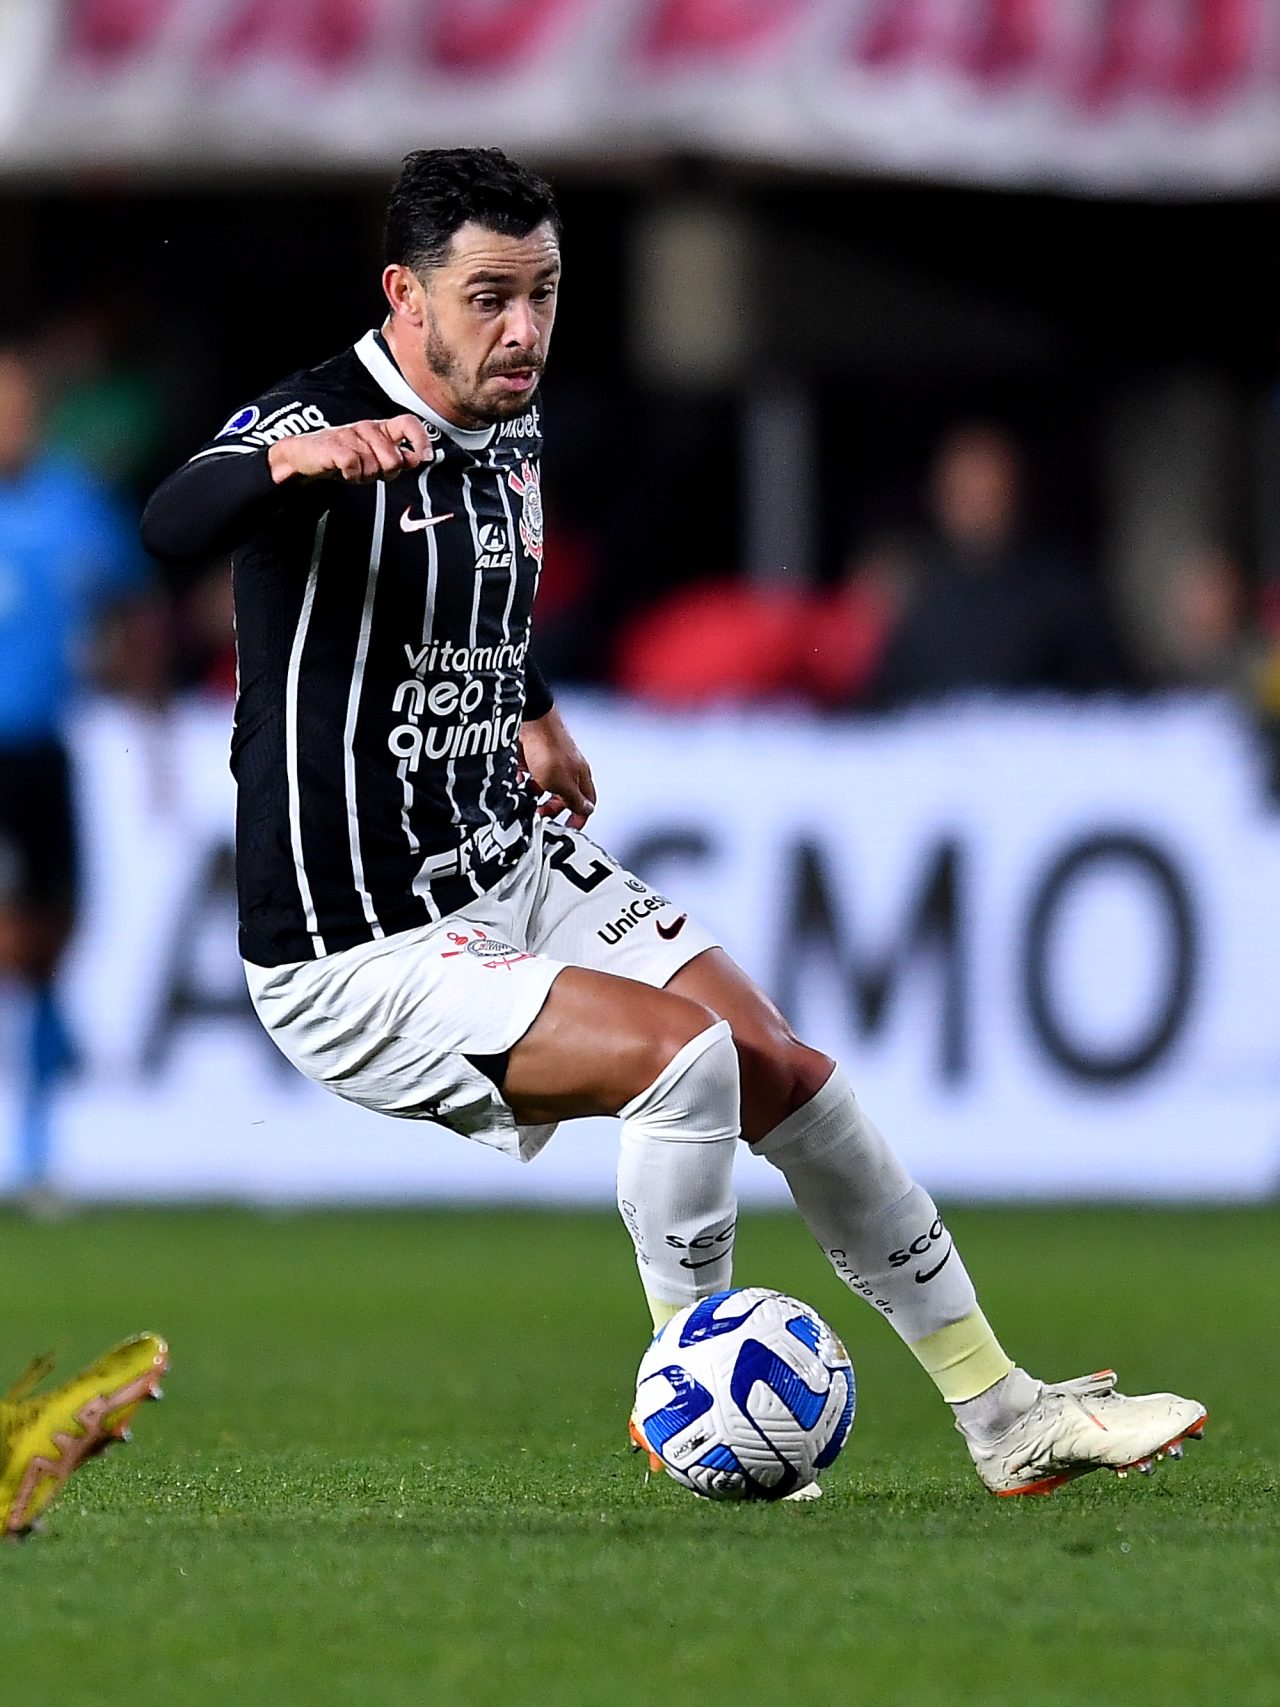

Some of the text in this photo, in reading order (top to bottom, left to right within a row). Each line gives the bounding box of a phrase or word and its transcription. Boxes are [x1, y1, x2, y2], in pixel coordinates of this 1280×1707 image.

[475, 553, 513, 569] ALE
[392, 680, 484, 716] neo
[829, 1248, 895, 1315] Cartão de
